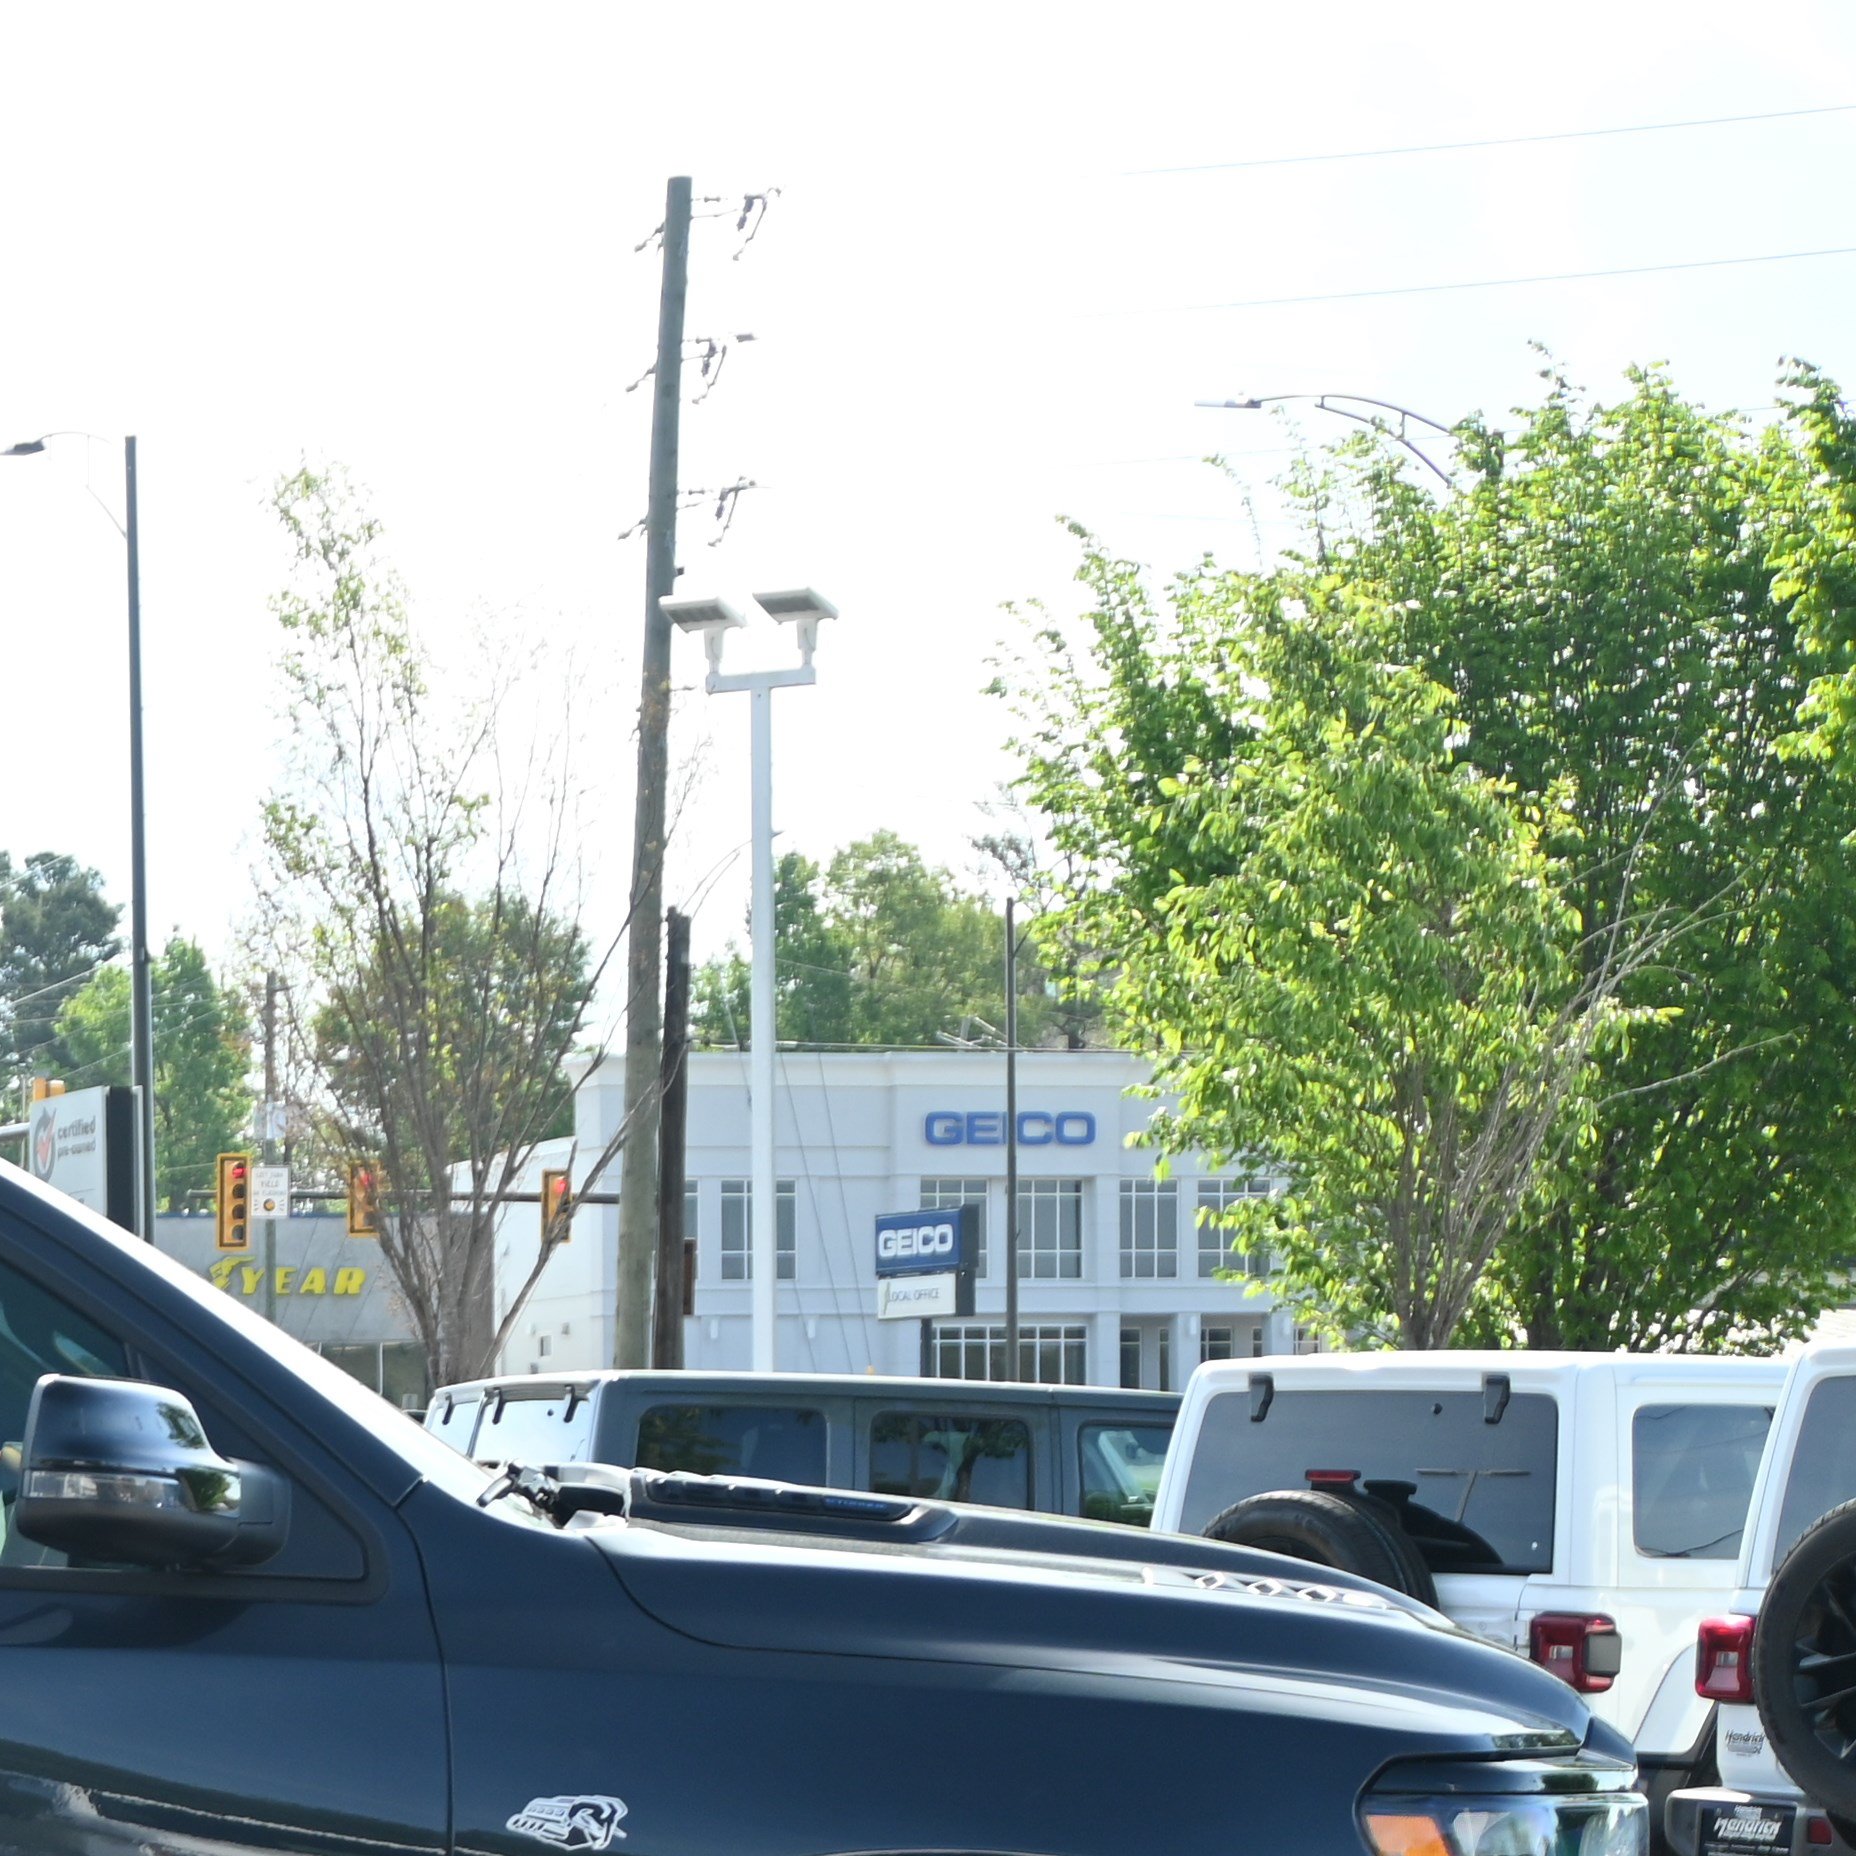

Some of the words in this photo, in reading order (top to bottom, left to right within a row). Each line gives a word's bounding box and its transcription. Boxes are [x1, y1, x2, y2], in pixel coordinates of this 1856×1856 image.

[57, 1115, 96, 1141] certified
[925, 1110, 1096, 1146] GEICO
[878, 1223, 954, 1258] GEICO
[913, 1287, 940, 1300] OFFICE
[1714, 1817, 1783, 1839] Hendrick
